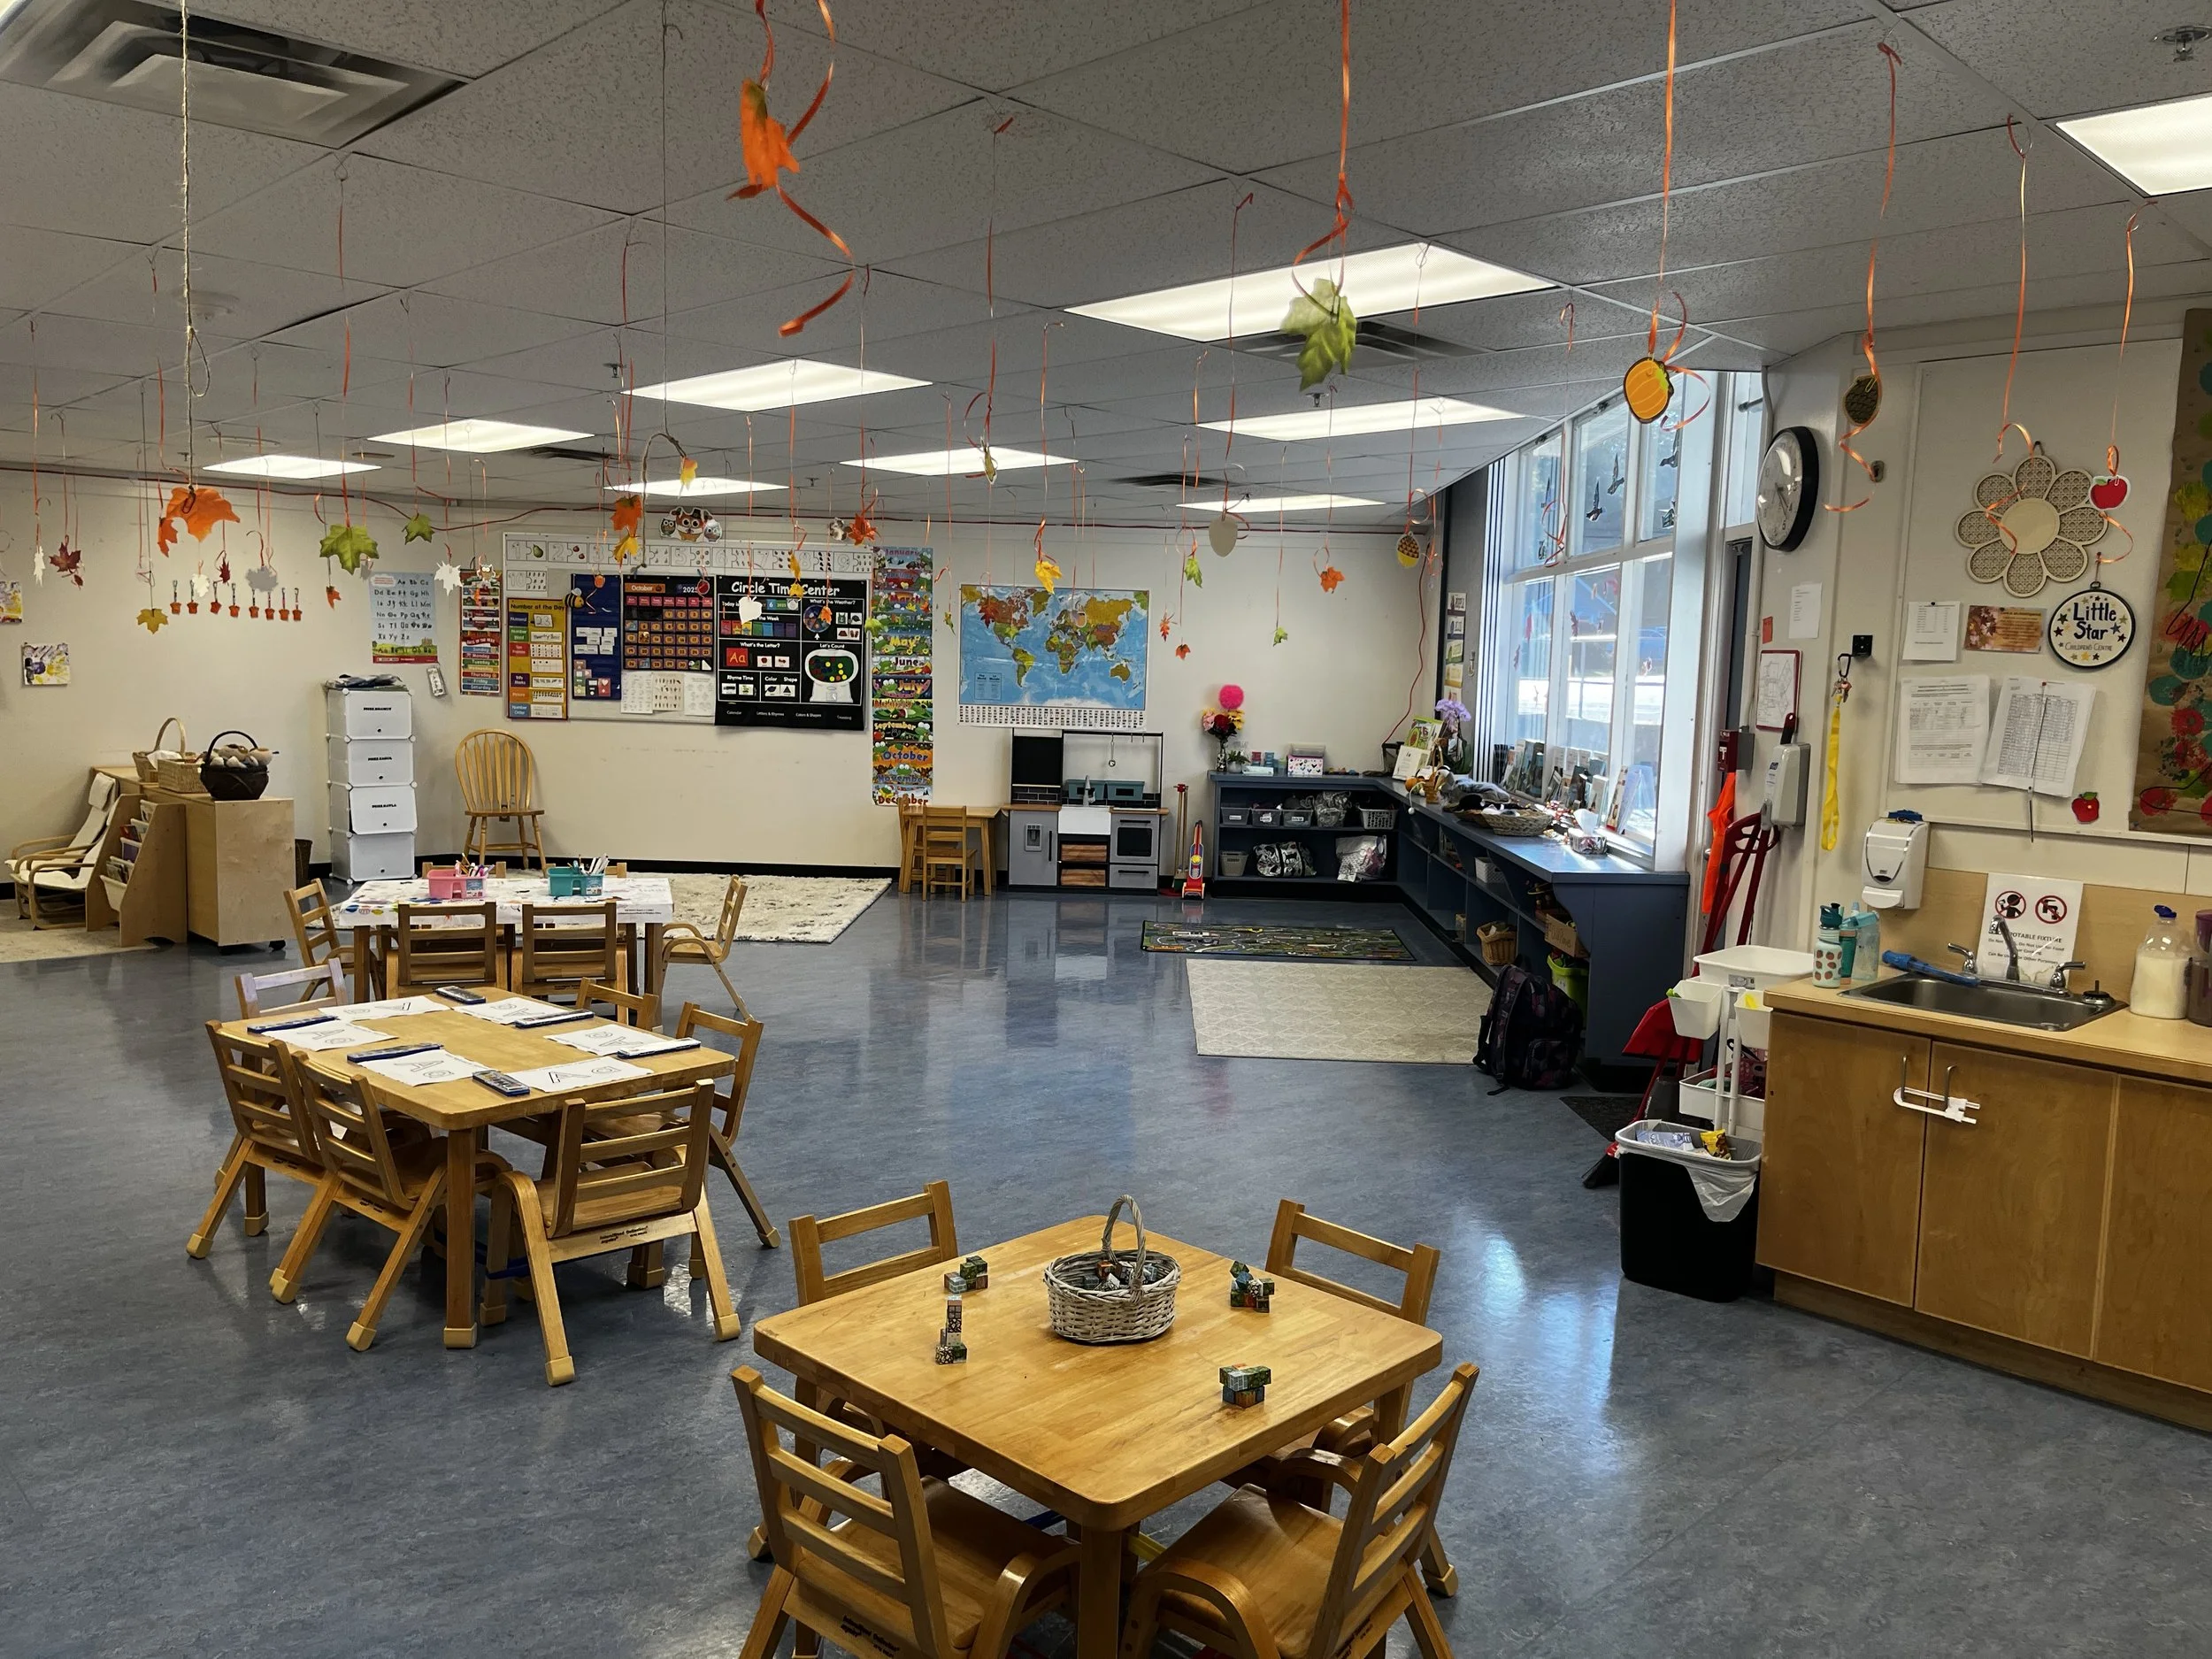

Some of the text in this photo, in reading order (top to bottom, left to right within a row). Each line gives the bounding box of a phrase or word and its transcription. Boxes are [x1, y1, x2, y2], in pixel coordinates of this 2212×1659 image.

[732, 582, 840, 596] Circle Tim Center
[2073, 603, 2116, 621] Little
[2074, 621, 2108, 640] Star
[890, 636, 915, 649] May
[730, 652, 746, 663] Aa
[894, 657, 918, 666] June
[898, 680, 923, 695] July
[874, 721, 916, 730] September
[883, 751, 928, 761] October
[878, 774, 926, 783] November
[878, 793, 928, 805] Decber
